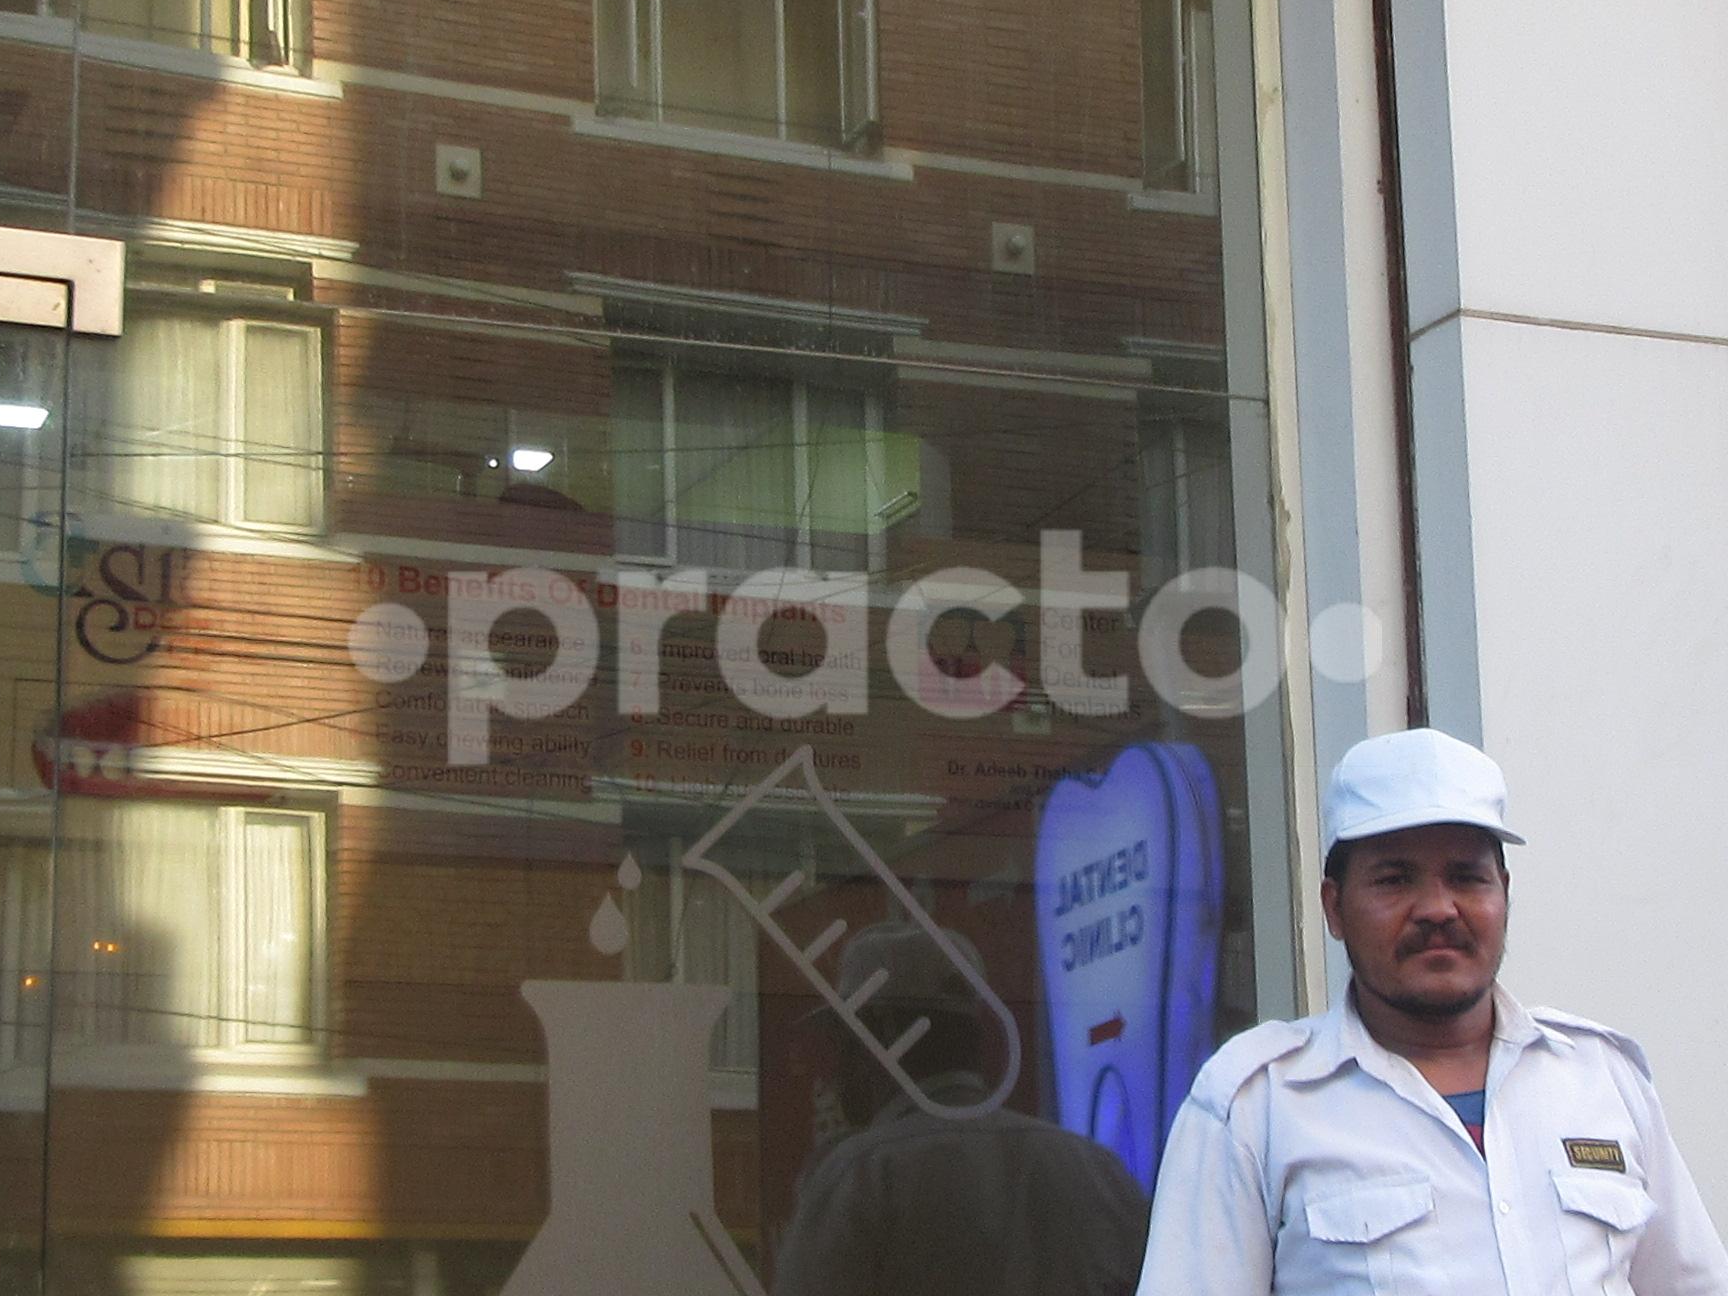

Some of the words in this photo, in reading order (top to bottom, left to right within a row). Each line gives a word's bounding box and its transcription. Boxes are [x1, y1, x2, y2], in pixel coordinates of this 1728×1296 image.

[399, 566, 535, 601] Benefits
[549, 577, 587, 607] Of
[598, 583, 702, 611] Dental
[709, 592, 846, 624] Implants
[461, 628, 585, 652] appearance
[758, 648, 795, 666] oral
[801, 649, 862, 671] health
[754, 677, 803, 699] bone
[809, 682, 850, 702] loss
[657, 707, 729, 729] Secure
[736, 712, 773, 731] and
[780, 715, 854, 735] durable
[376, 724, 426, 747] Easy
[531, 736, 590, 758] ability
[656, 741, 715, 761] Relief
[722, 744, 768, 764] from
[774, 746, 861, 771] dtures
[504, 768, 592, 794] cleaning
